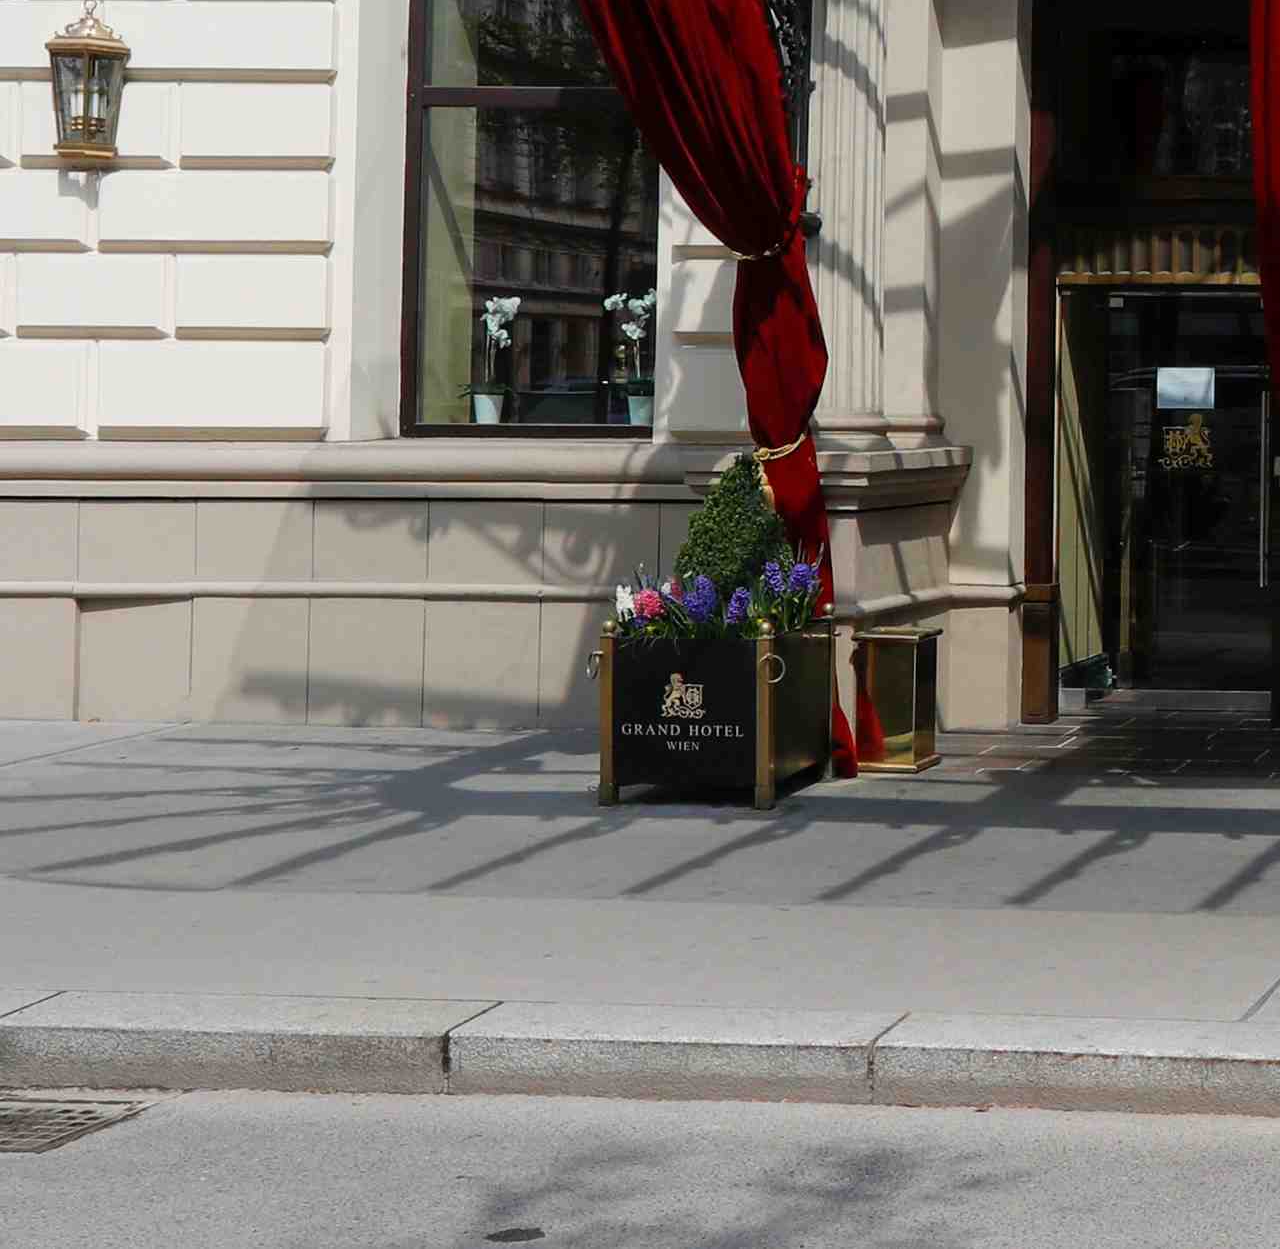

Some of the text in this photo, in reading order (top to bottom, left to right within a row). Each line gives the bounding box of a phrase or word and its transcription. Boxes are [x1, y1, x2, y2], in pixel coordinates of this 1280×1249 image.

[621, 723, 744, 737] GRAND HOTEL
[666, 740, 700, 752] WIEN
